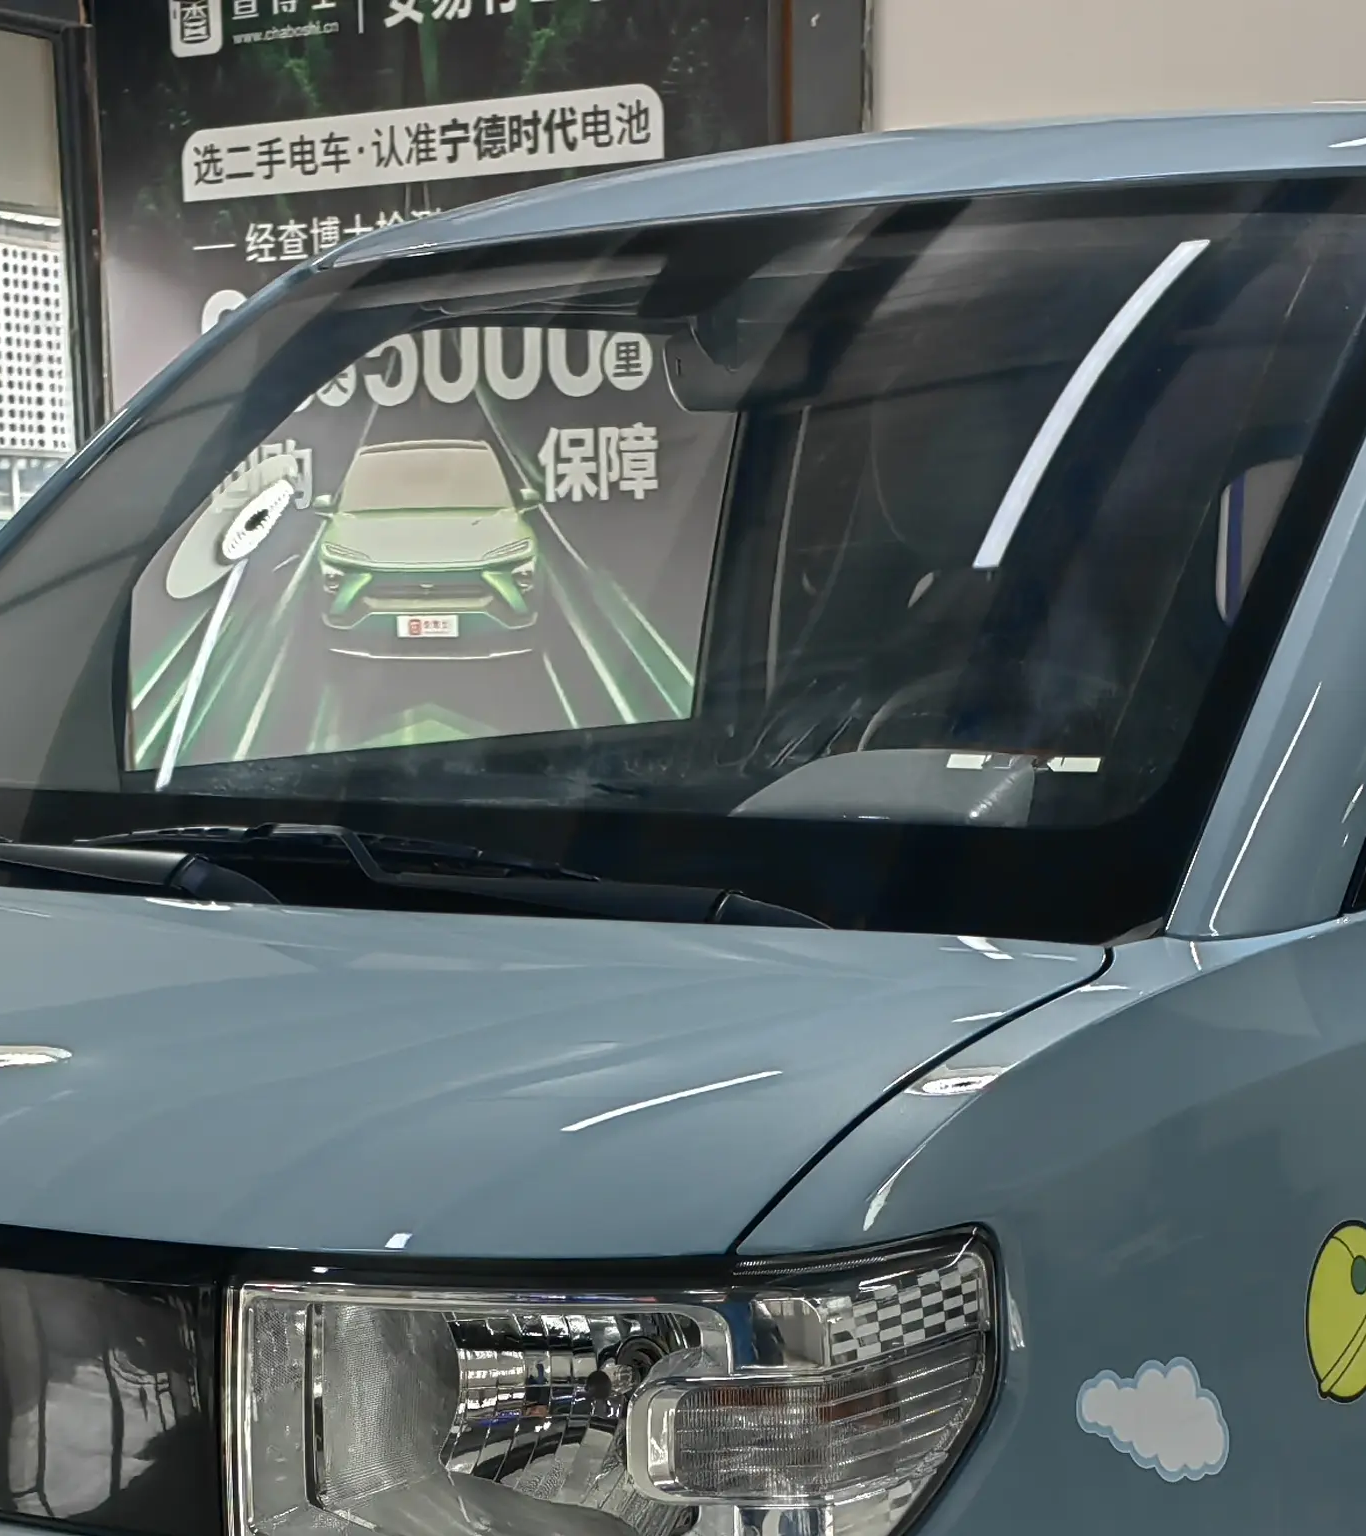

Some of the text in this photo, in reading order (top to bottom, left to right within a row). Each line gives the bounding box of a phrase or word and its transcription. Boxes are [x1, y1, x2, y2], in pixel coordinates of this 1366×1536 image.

[233, 21, 339, 44] www.chaboshi.cn
[193, 99, 651, 186] 选二手电车·认准宁德时代电池
[538, 422, 659, 503] 保障
